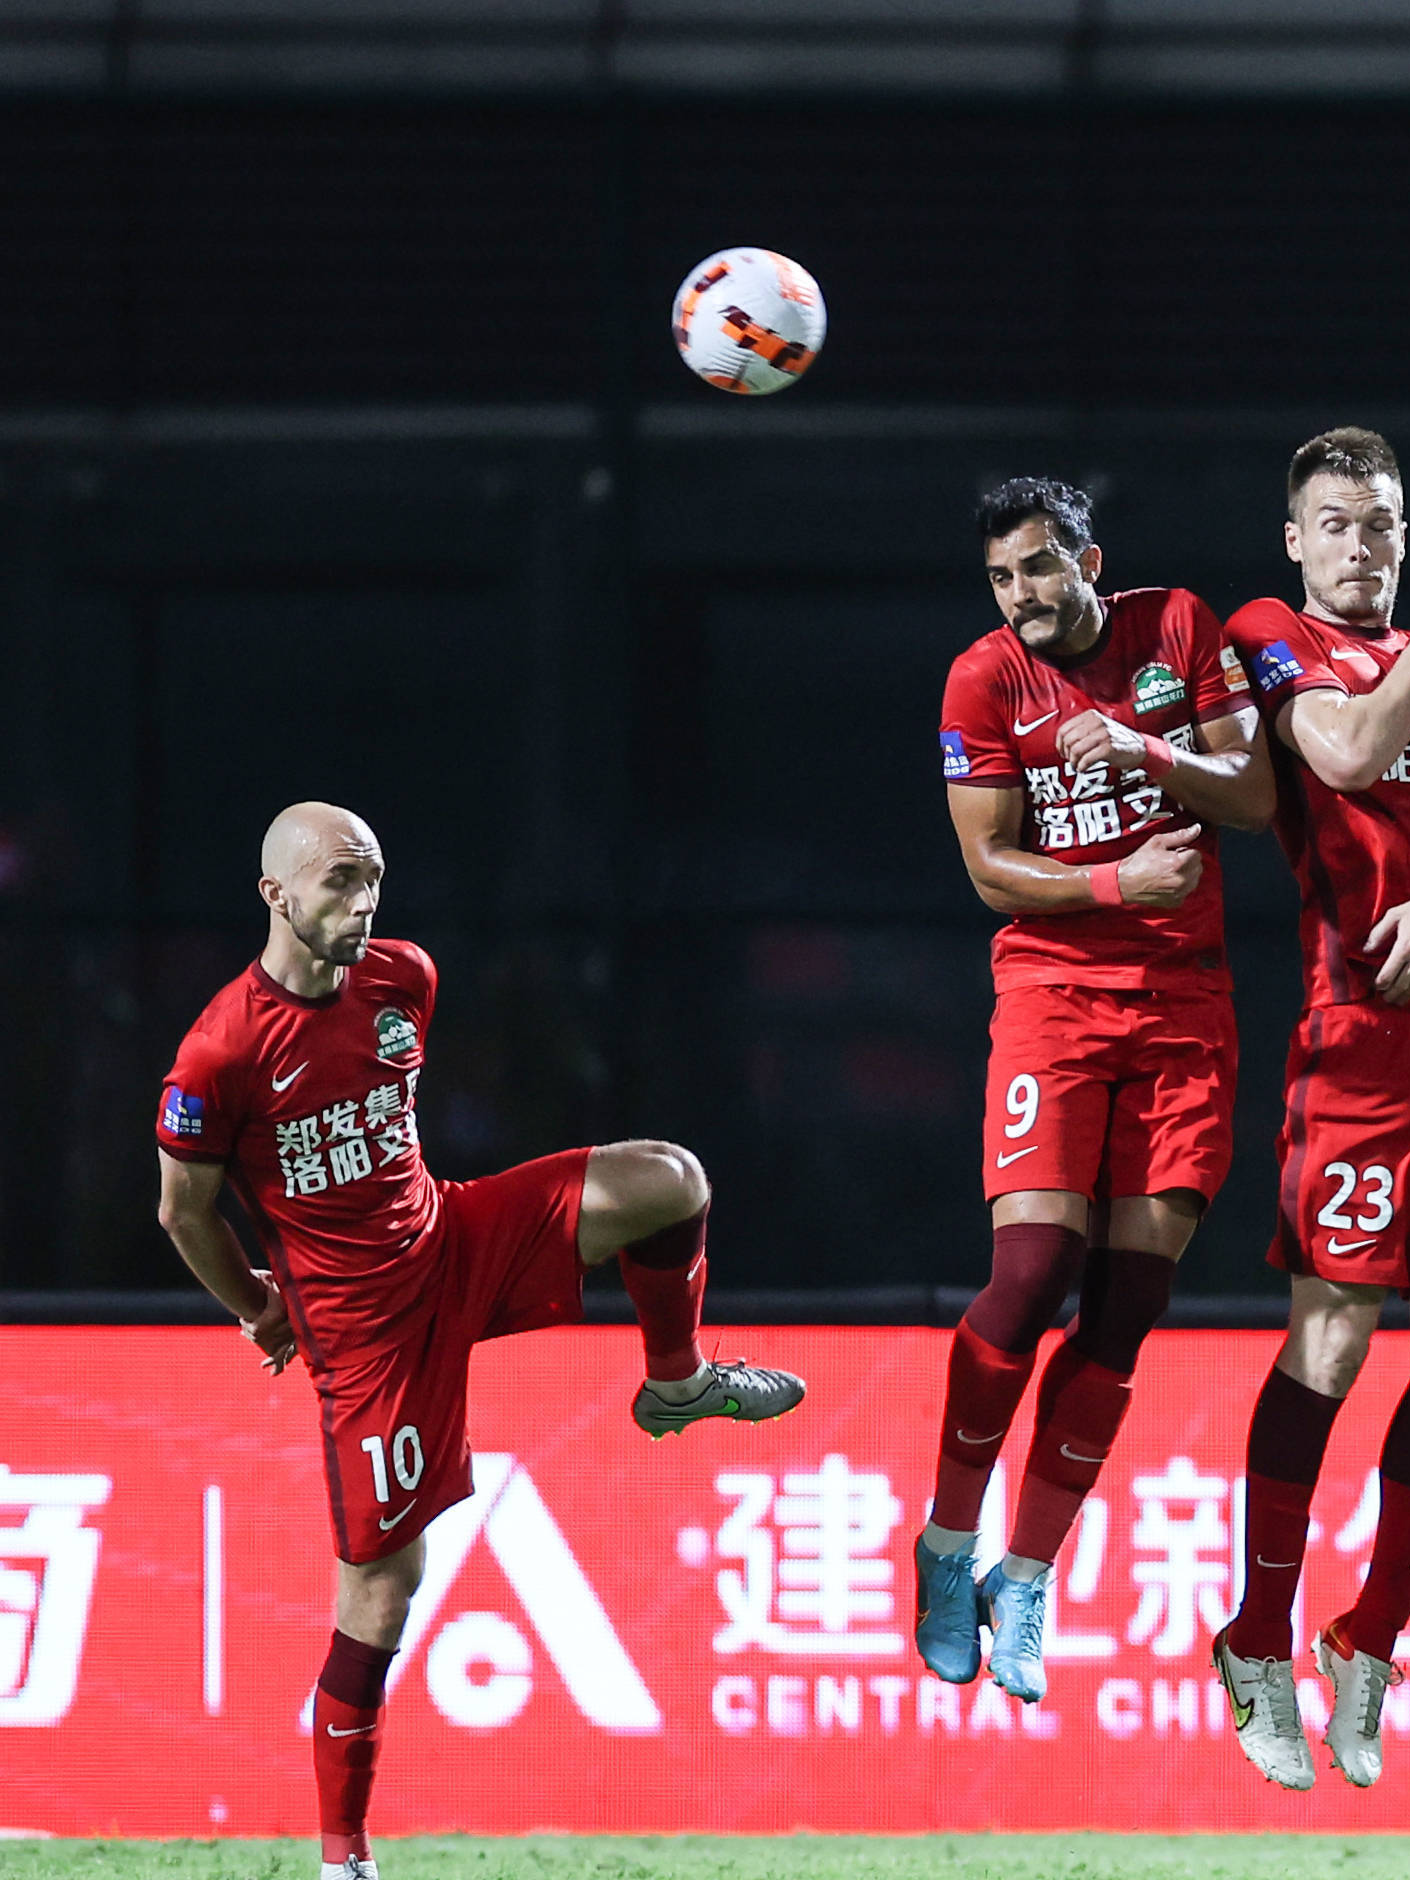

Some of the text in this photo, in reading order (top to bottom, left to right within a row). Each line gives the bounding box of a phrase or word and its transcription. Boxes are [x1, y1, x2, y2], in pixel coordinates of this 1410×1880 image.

[1024, 722, 1198, 806] 郑发团
[1035, 786, 1184, 848] 洛阳文
[1004, 1073, 1039, 1138] 9
[1317, 1161, 1394, 1232] 23
[361, 1425, 424, 1503] 10
[711, 1675, 1059, 1738] CENTRAL
[1096, 1678, 1331, 1738] CHI
